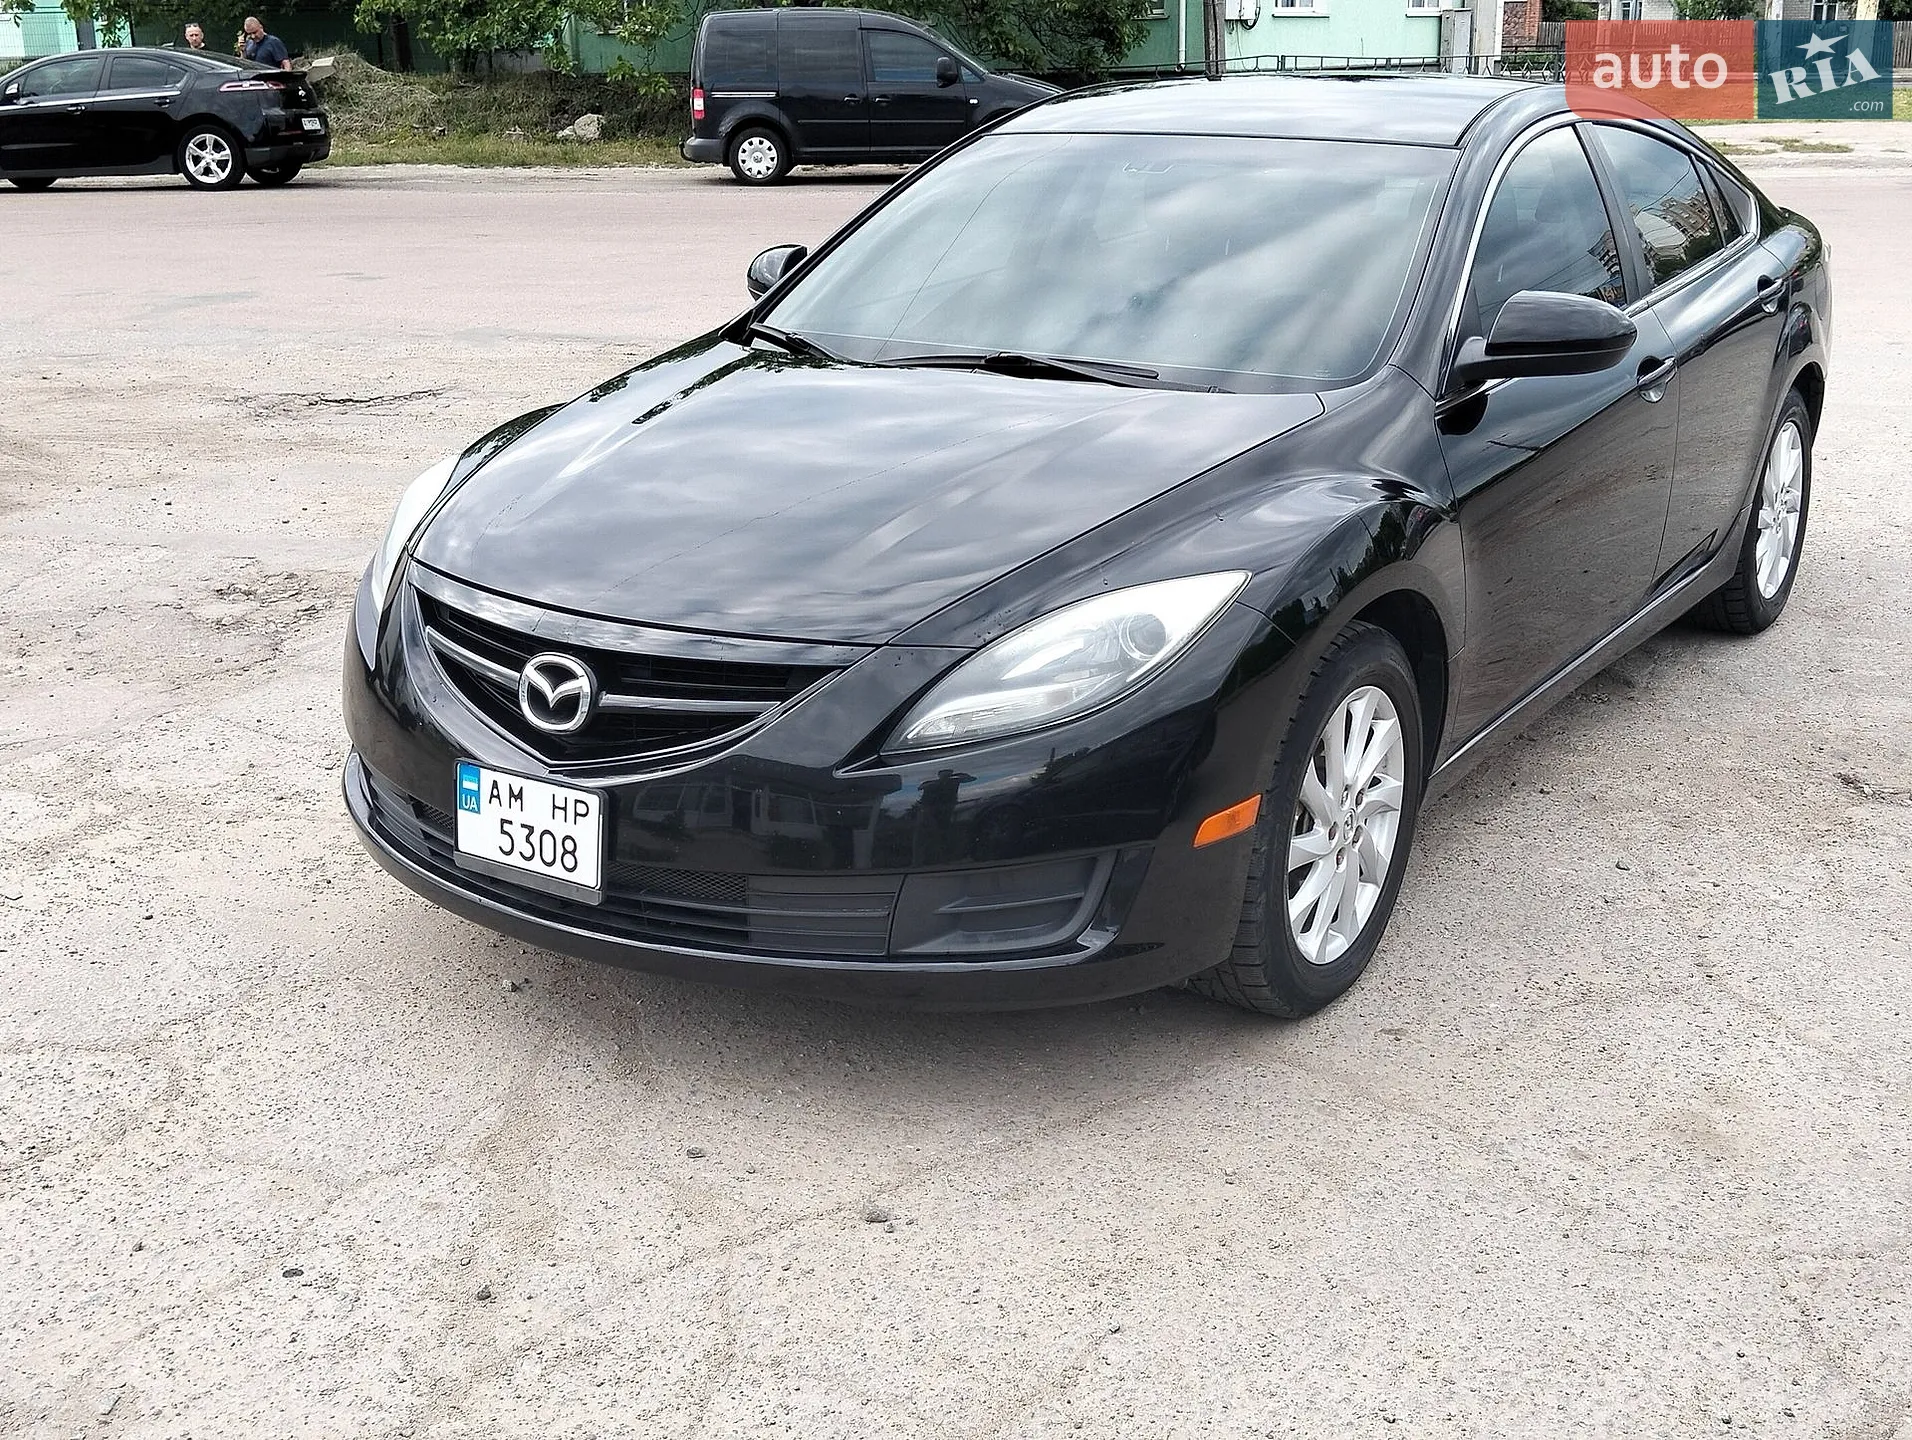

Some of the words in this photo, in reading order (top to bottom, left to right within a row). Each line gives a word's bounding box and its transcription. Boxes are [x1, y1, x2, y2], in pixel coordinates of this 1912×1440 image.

[462, 794, 478, 811] UA
[488, 779, 524, 812] AM
[552, 793, 590, 825] HP
[498, 817, 578, 873] 5308
